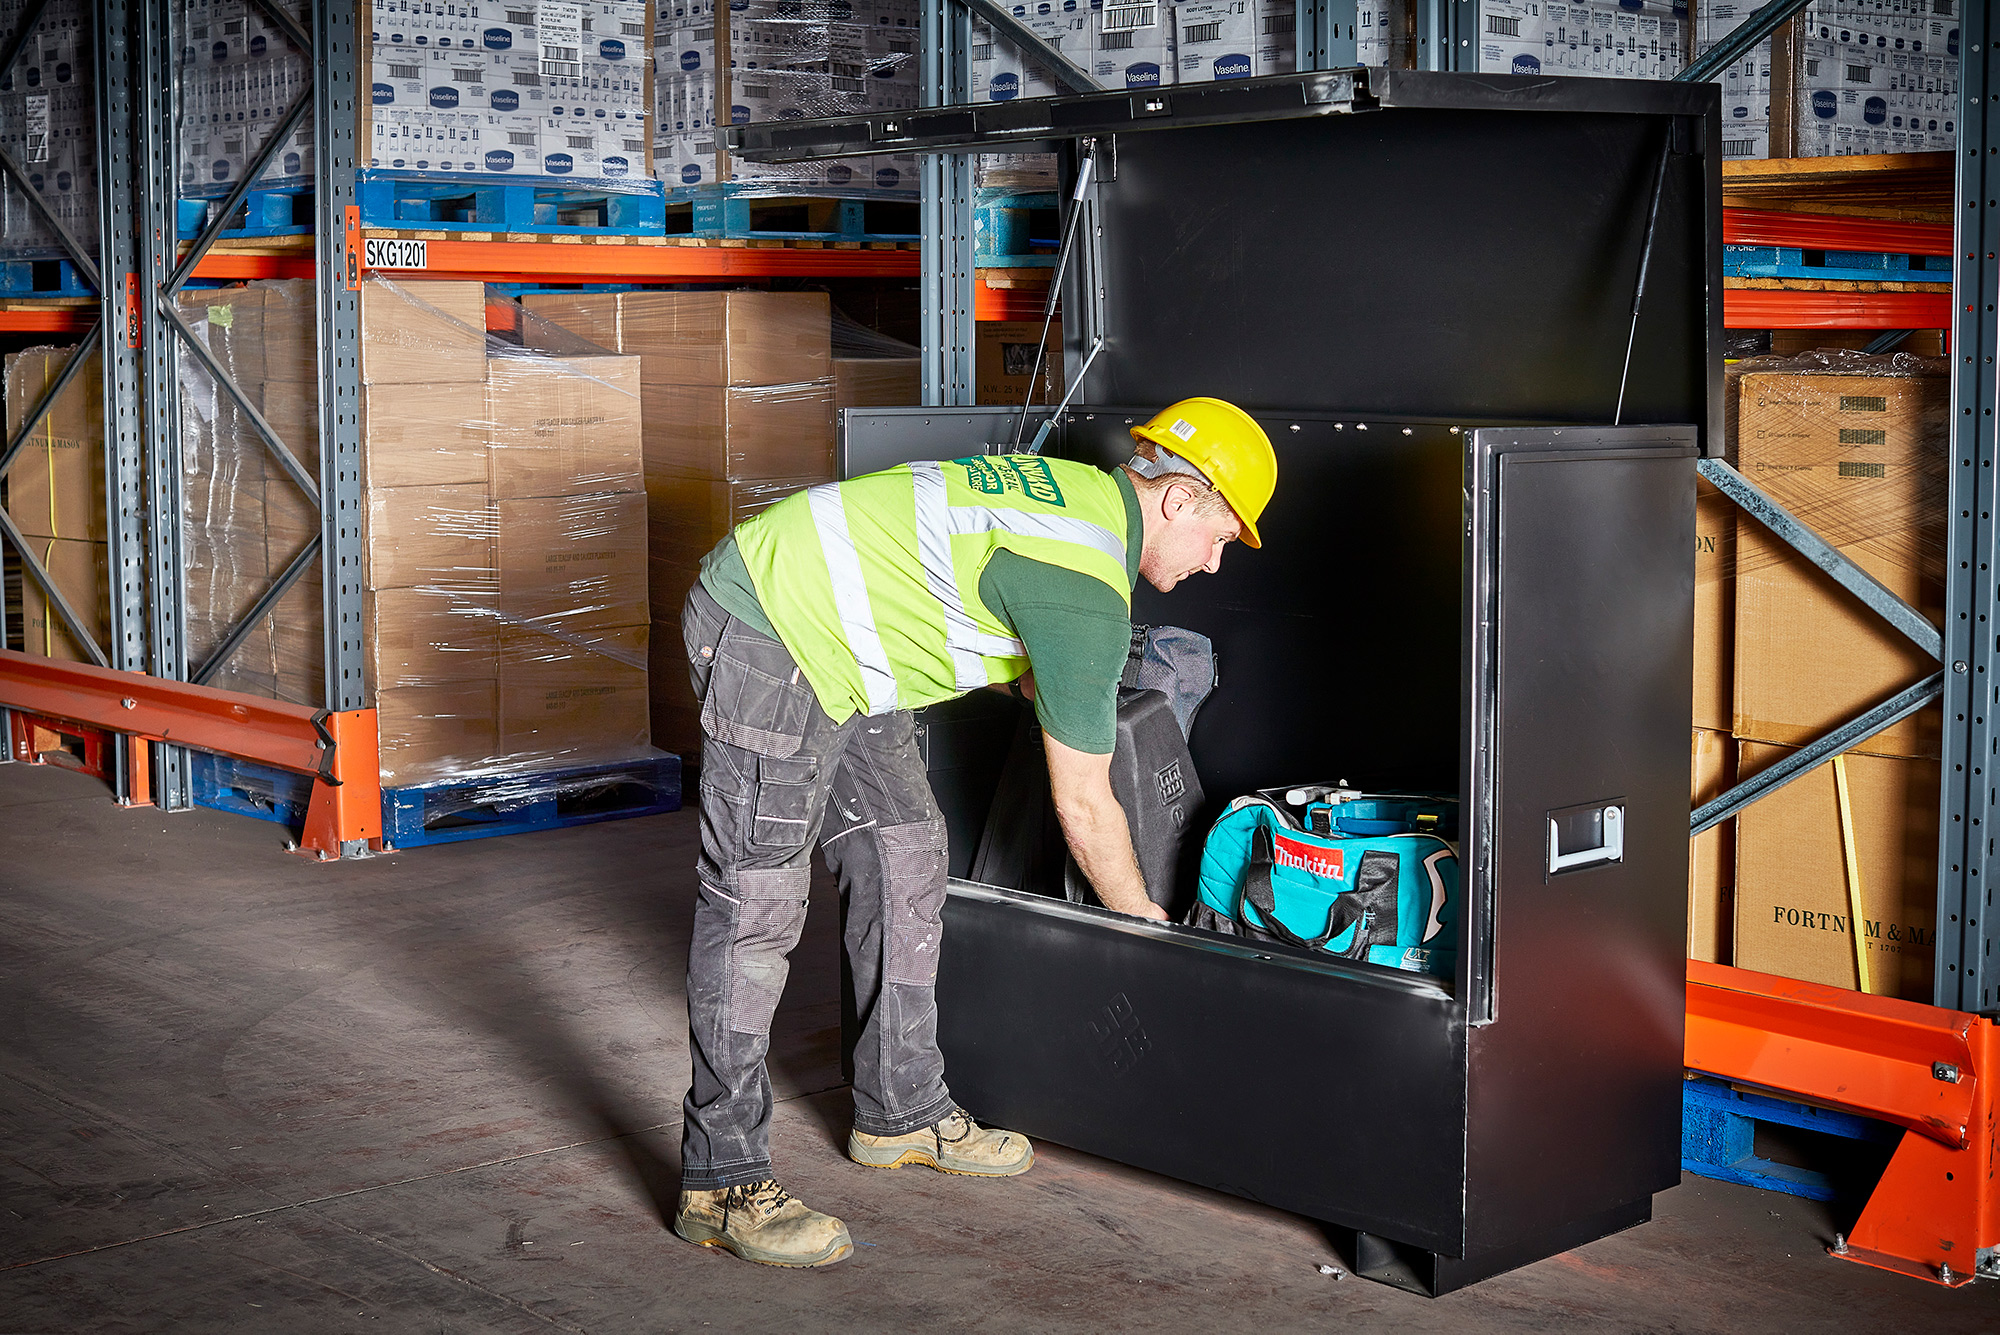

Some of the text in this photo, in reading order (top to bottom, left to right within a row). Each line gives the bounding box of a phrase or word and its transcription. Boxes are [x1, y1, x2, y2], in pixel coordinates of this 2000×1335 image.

[485, 33, 511, 43] Vaseline
[600, 45, 624, 54] Vaseline
[1215, 64, 1249, 74] Vaseline
[1513, 63, 1539, 75] Vaseline
[1126, 72, 1159, 82] Vaseline
[990, 82, 1018, 92] Vaseline
[373, 88, 392, 98] seline
[430, 93, 457, 101] Vaseline
[492, 95, 518, 104] Vaseline
[485, 156, 512, 164] Vaseline
[546, 159, 572, 167] Vaseline
[366, 240, 426, 267] SKG1201
[1016, 386, 1023, 395] kg
[57, 440, 80, 449] MASON
[1773, 906, 1881, 938] FORTNM
[1887, 924, 1902, 941] &
[1880, 944, 1902, 953] 1707
